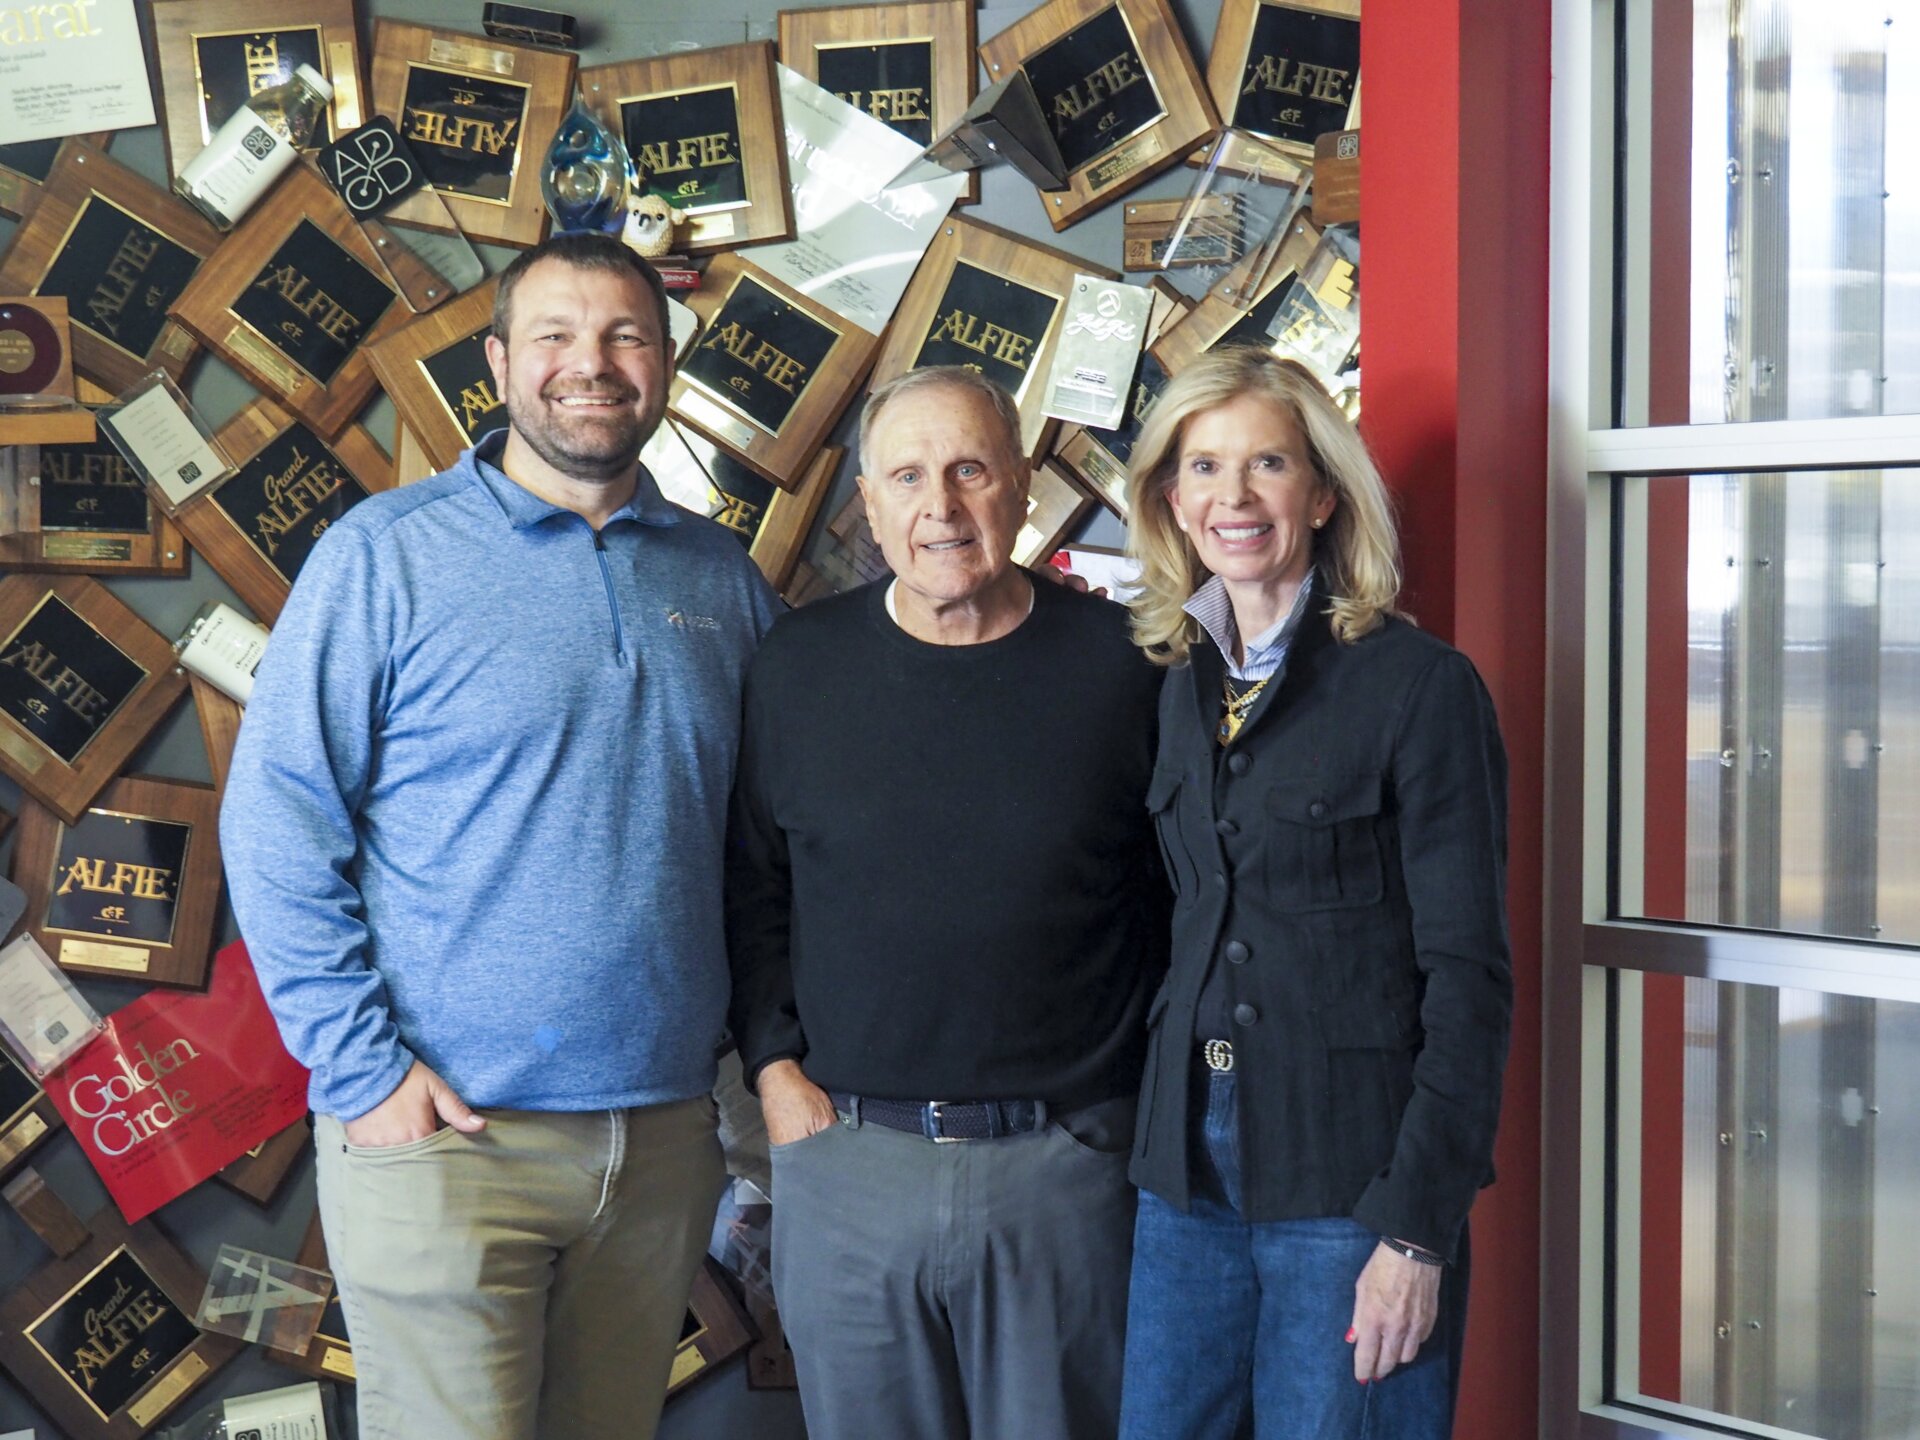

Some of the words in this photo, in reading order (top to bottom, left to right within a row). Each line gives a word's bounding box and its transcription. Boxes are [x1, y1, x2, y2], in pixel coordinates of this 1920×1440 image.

[1053, 51, 1146, 137] ALFIE
[1242, 55, 1349, 106] ALFIE
[408, 109, 518, 156] ALFIE
[637, 132, 736, 184] ALFIE
[87, 228, 158, 337] ALFIE
[256, 265, 361, 345] ALFIE
[704, 321, 807, 392] ALFIE
[929, 309, 1033, 370] ALFIE
[40, 452, 138, 486] ALFIE
[264, 447, 309, 503] Grand
[256, 461, 345, 550] ALFIE
[1, 640, 110, 727] ALFIE
[57, 857, 172, 900] ALFIE
[69, 1038, 200, 1118] Golden
[93, 1083, 196, 1156] Circle
[75, 1290, 167, 1391] ALFIE
[85, 1277, 131, 1337] Grand
